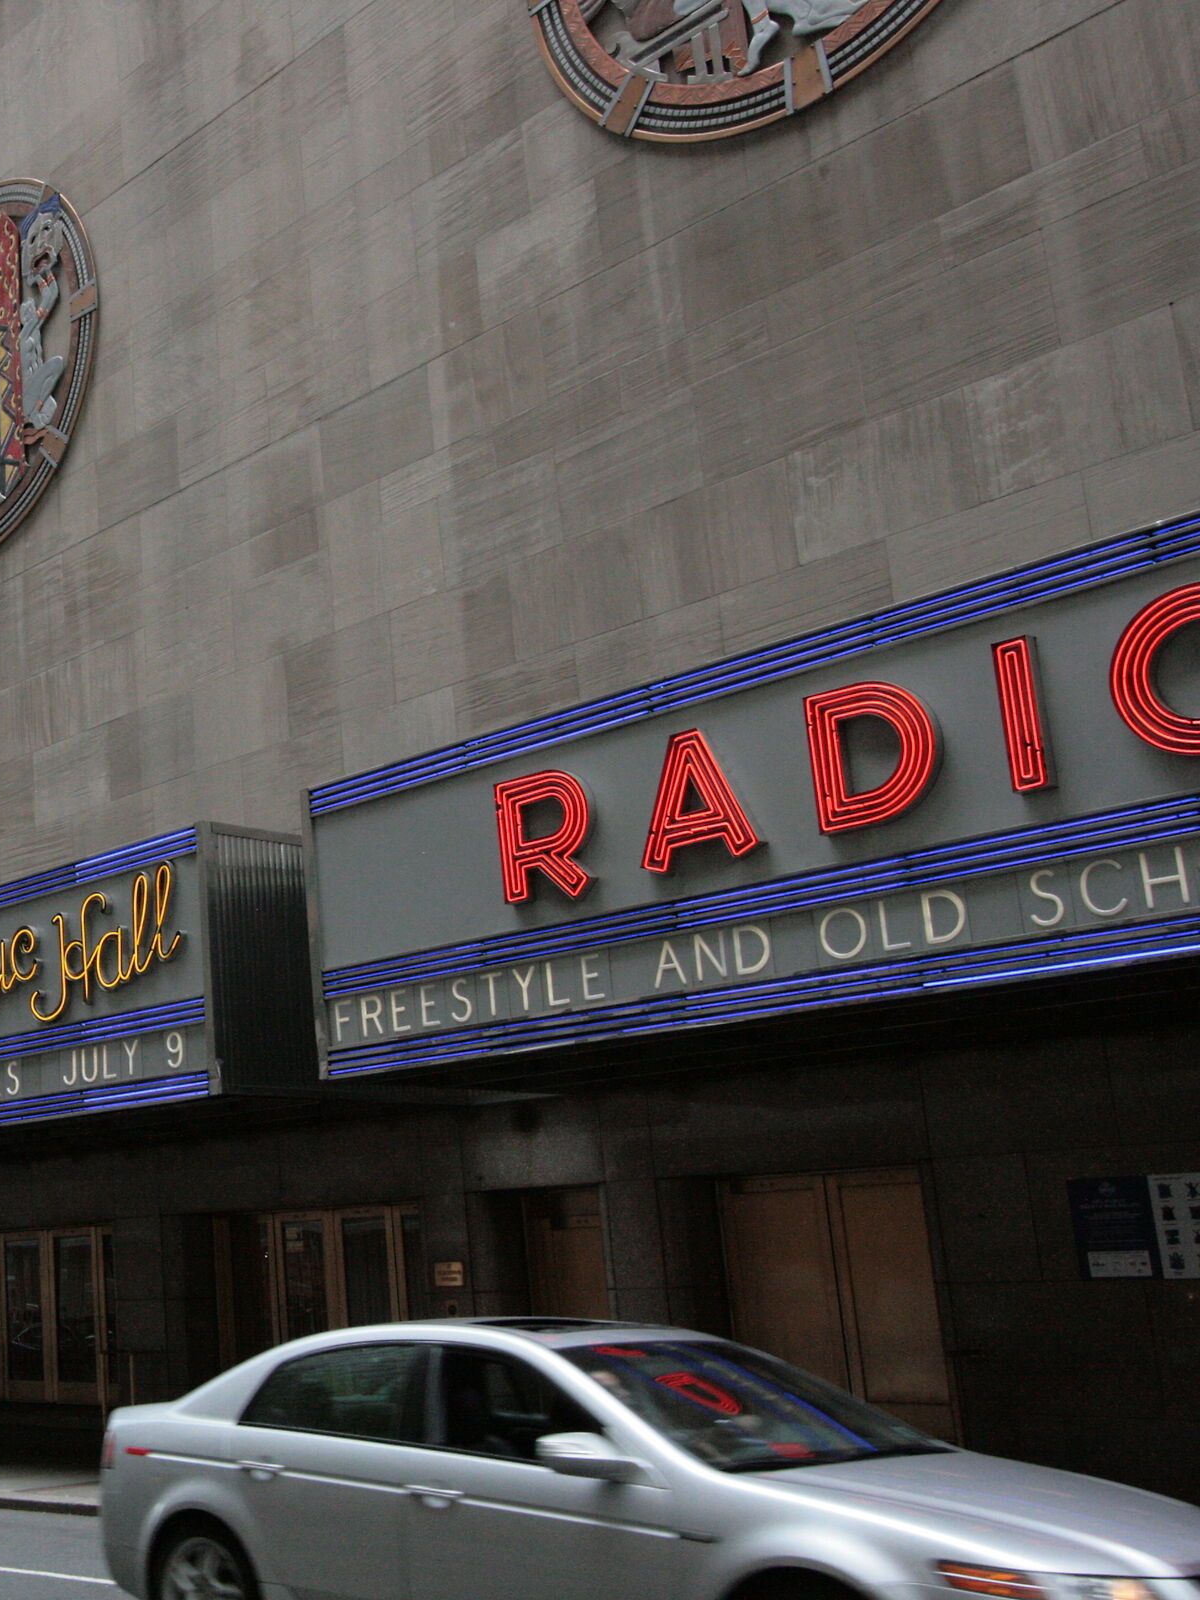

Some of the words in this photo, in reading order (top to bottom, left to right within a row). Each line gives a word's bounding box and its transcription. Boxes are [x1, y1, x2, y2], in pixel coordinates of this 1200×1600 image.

[493, 581, 1200, 905] RADIO
[334, 953, 605, 1042] FREESTYLE
[654, 925, 771, 989] AND
[819, 889, 966, 960] OLD
[63, 1039, 138, 1086] JULY
[166, 1032, 184, 1068] 9
